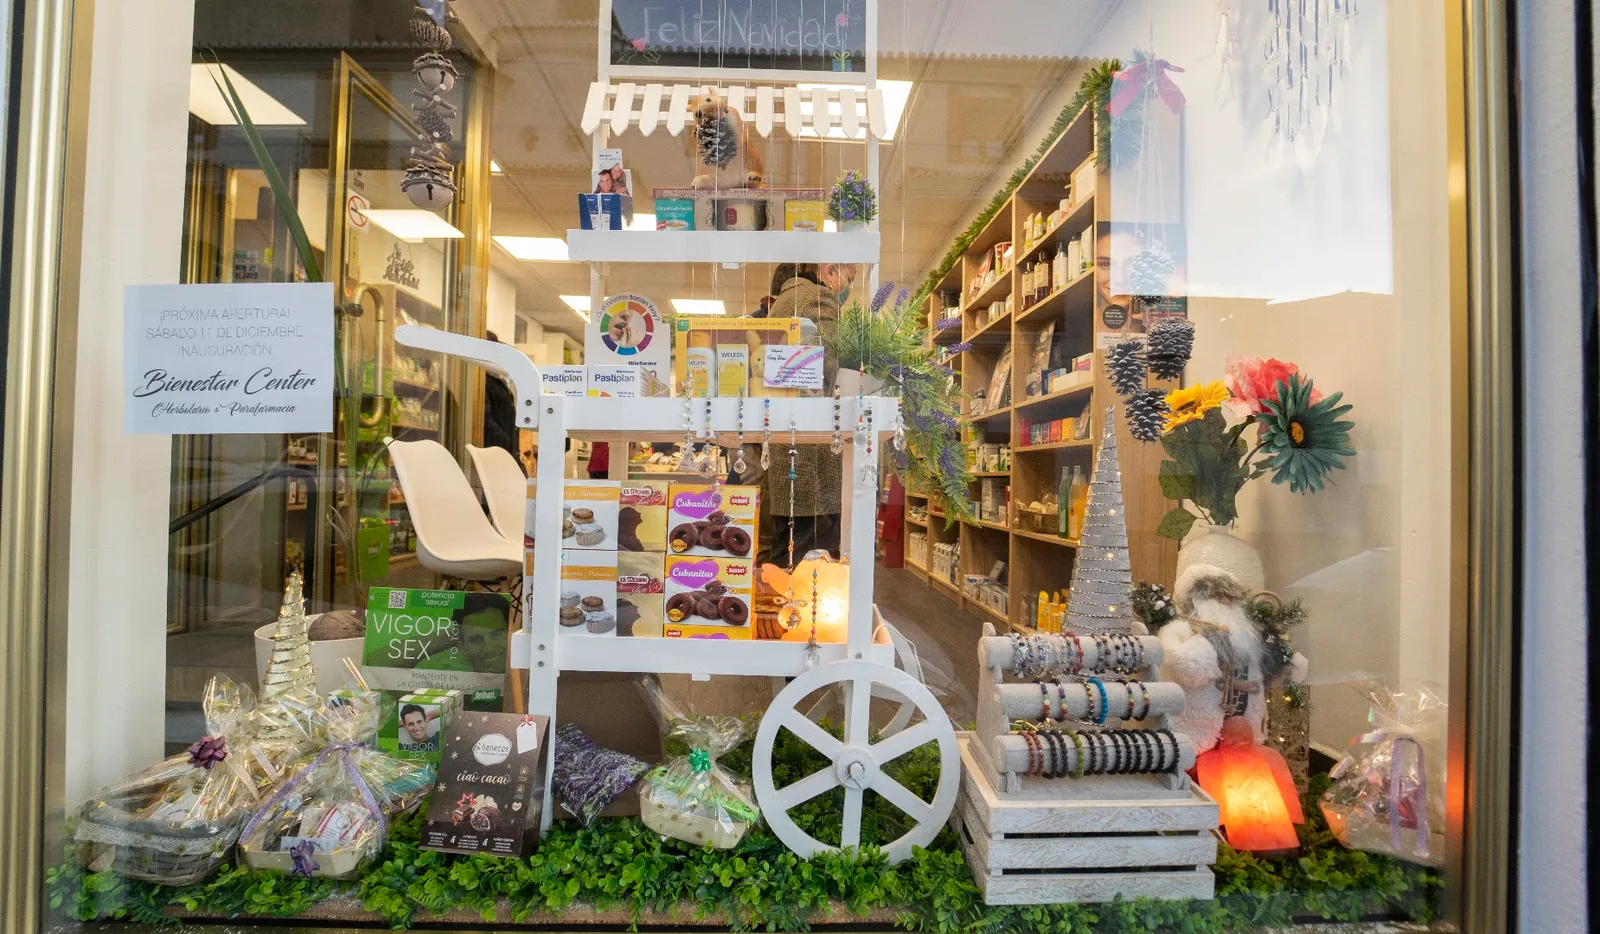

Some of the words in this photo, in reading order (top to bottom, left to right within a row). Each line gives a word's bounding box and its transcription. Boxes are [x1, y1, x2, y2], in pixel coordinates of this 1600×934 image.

[643, 7, 720, 44] Feliz
[728, 8, 846, 48] Navidad
[159, 307, 219, 322] ¡PRÓXIMA
[221, 308, 290, 319] APERTURA!
[629, 294, 649, 307] tocan
[648, 304, 661, 322] hoy?
[146, 325, 197, 339] SÁBADO
[200, 327, 211, 339] 11
[217, 326, 233, 338] DE
[236, 326, 304, 338] DICIEMBRE
[178, 342, 272, 357] INAUGURACIÓN
[133, 368, 240, 398] Bienestar
[244, 366, 317, 395] Center
[542, 373, 583, 384] Pastiplan
[594, 373, 635, 384] Pastiplan
[151, 401, 211, 418] Herbolario
[219, 401, 297, 417] Parafarmacia
[421, 591, 455, 600] potencia
[373, 613, 451, 637] VIGOR
[387, 638, 432, 661] SEX
[411, 672, 448, 682] MANTENTE
[449, 674, 459, 682] EN
[402, 742, 434, 752] VIGOR
[408, 752, 427, 760] SEX
[456, 770, 481, 783] ciao
[480, 774, 512, 785] cacao
